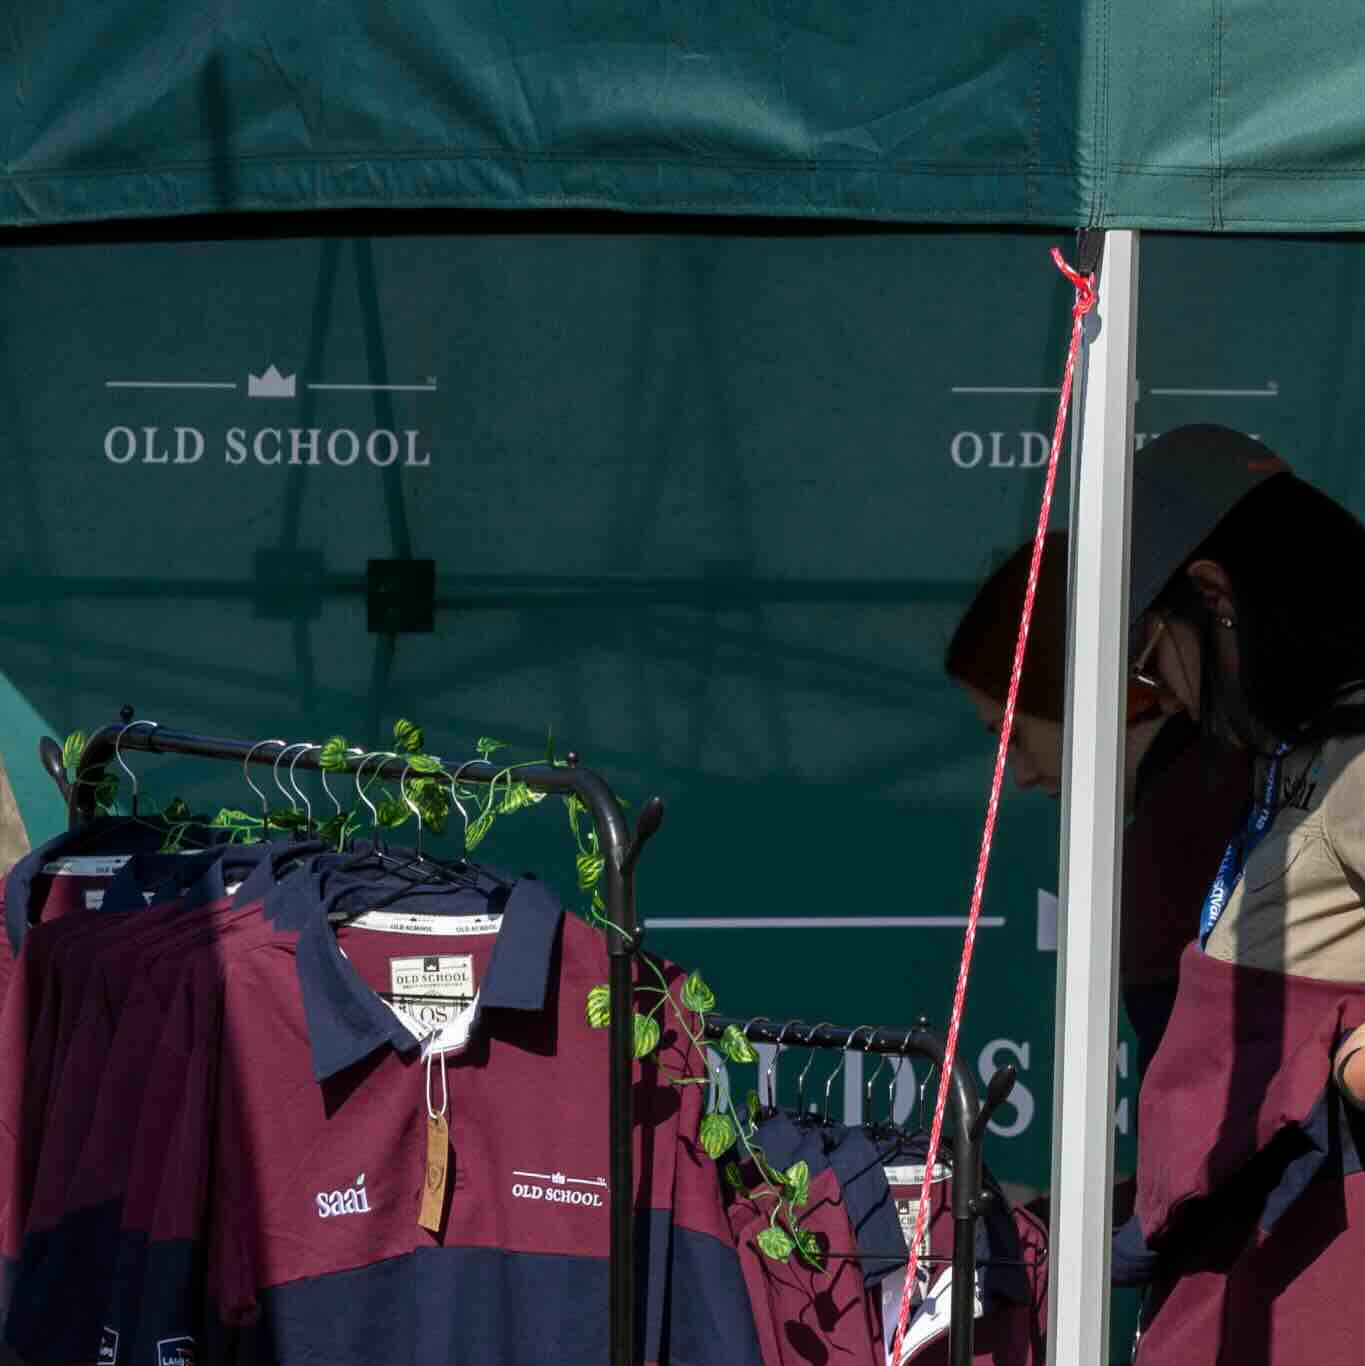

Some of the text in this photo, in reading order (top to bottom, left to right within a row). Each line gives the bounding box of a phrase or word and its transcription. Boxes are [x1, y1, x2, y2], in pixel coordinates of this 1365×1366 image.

[104, 426, 431, 467] OLD SCHOOL
[950, 431, 1049, 469] OLD
[396, 971, 470, 985] OLD SCHOOL
[315, 1172, 372, 1218] saai
[512, 1183, 603, 1208] OLD SCHOOL
